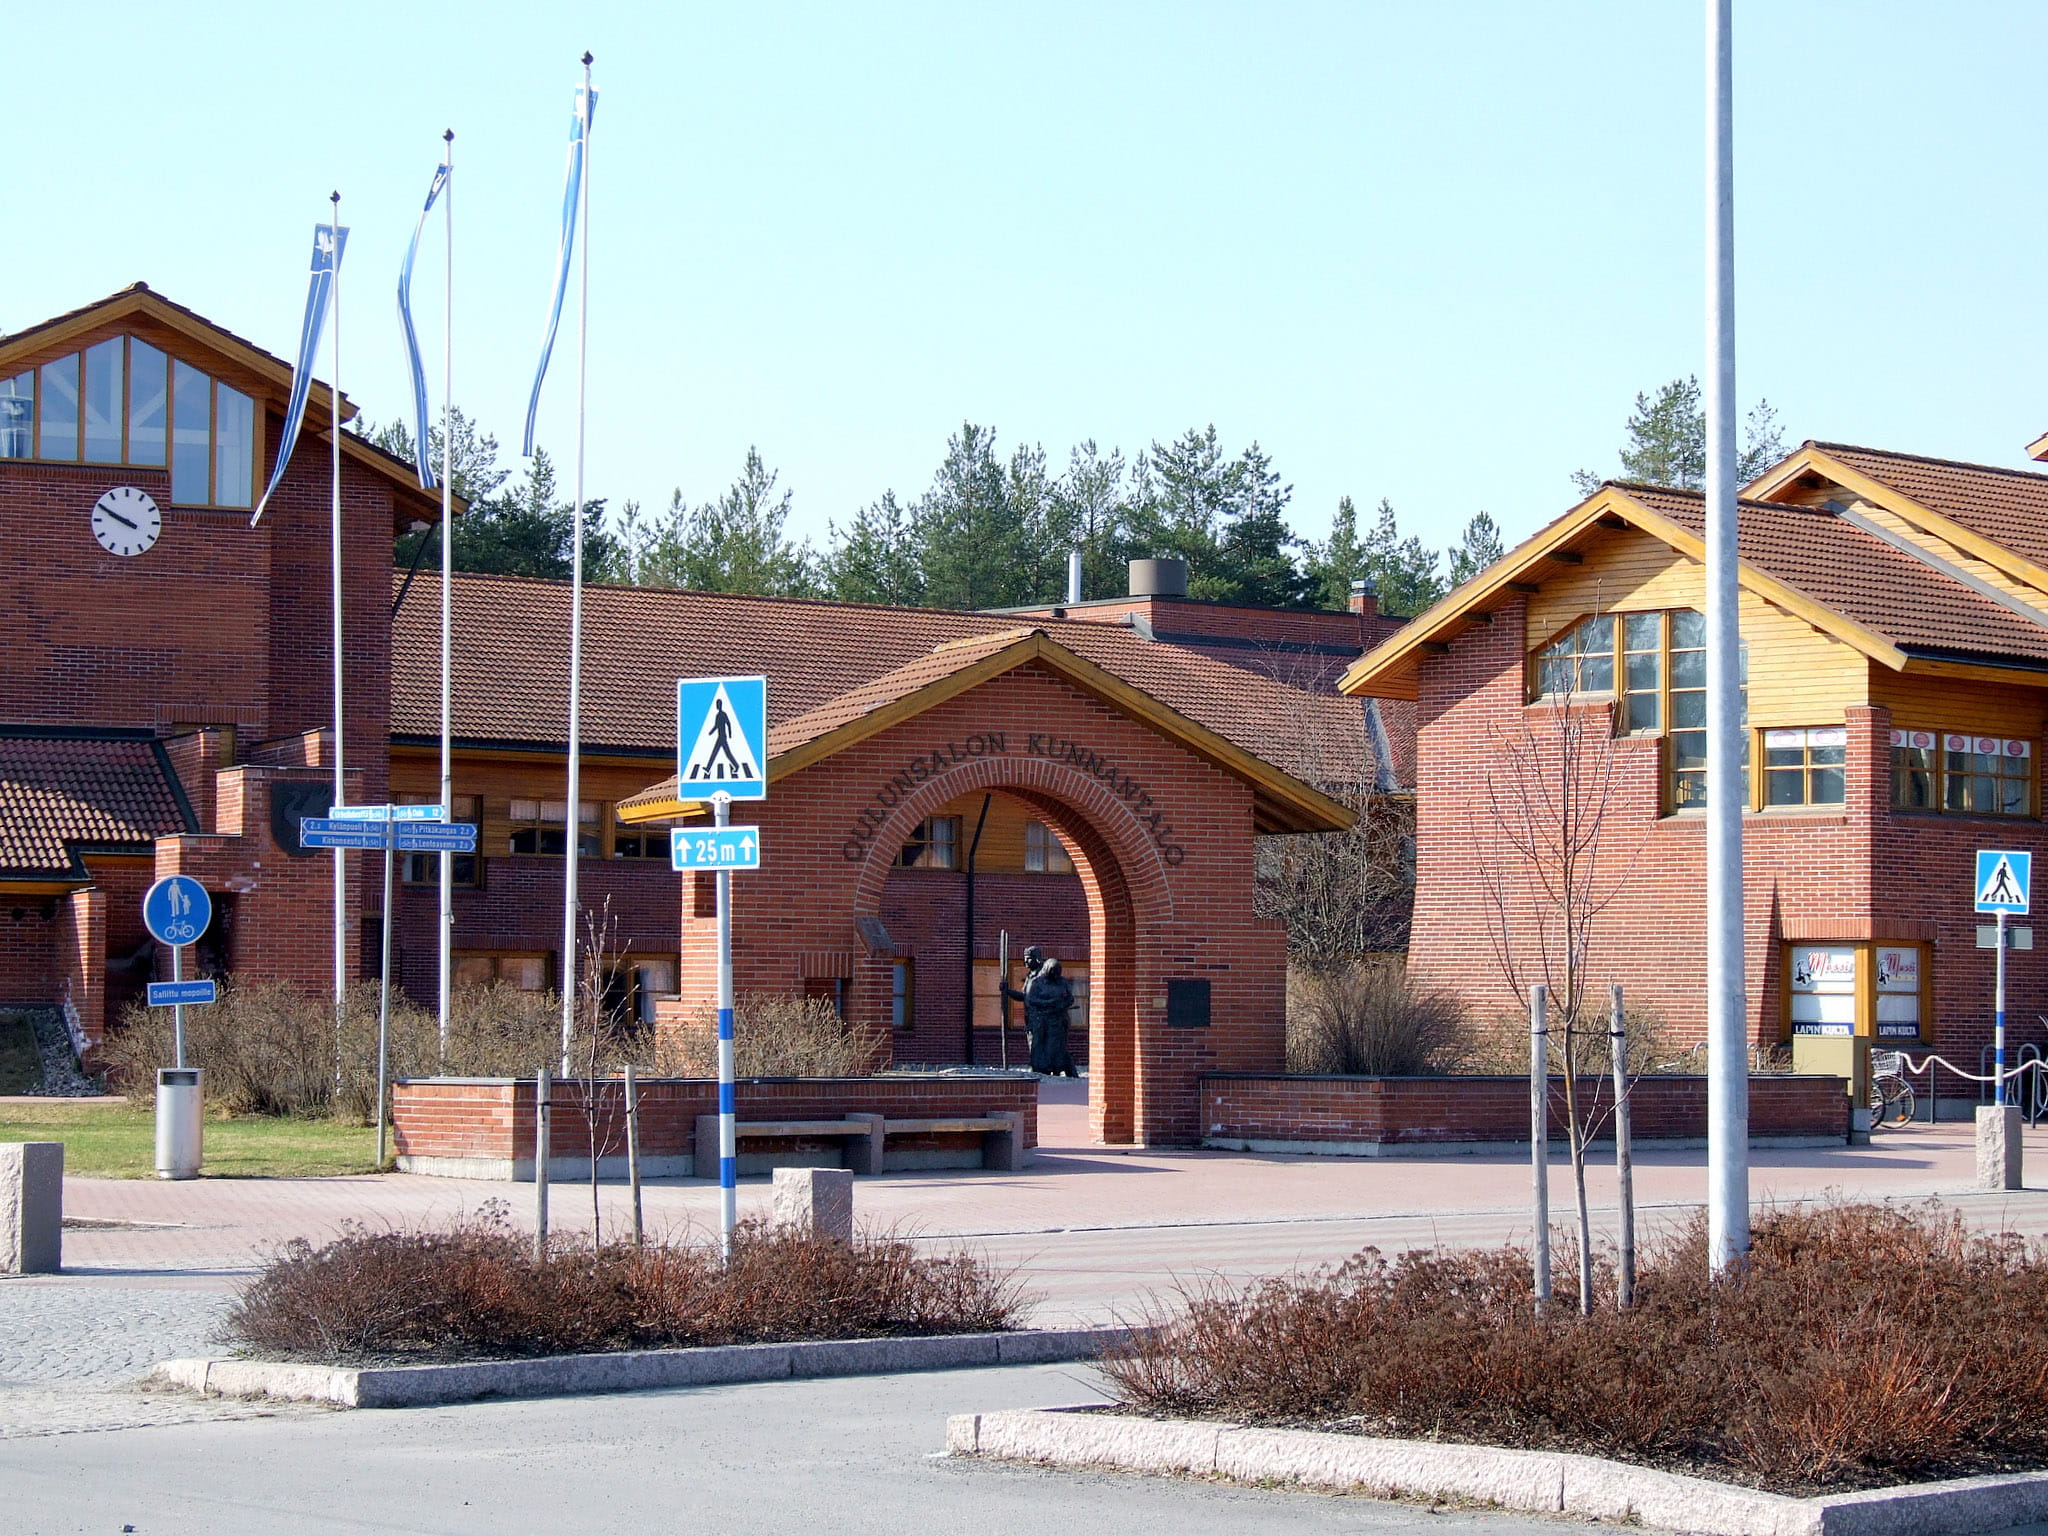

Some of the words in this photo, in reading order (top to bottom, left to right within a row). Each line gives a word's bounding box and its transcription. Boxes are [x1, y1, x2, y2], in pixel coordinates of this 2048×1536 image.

[843, 732, 1006, 862] OULUNSALON
[1028, 733, 1184, 867] KUNNANTALO
[696, 839, 717, 862] 25
[720, 844, 736, 862] m
[1795, 1025, 1820, 1035] LAPIN
[1821, 1025, 1850, 1036] KULTA
[1879, 1025, 1897, 1036] LAPIN
[1898, 1025, 1917, 1036] KULTA
